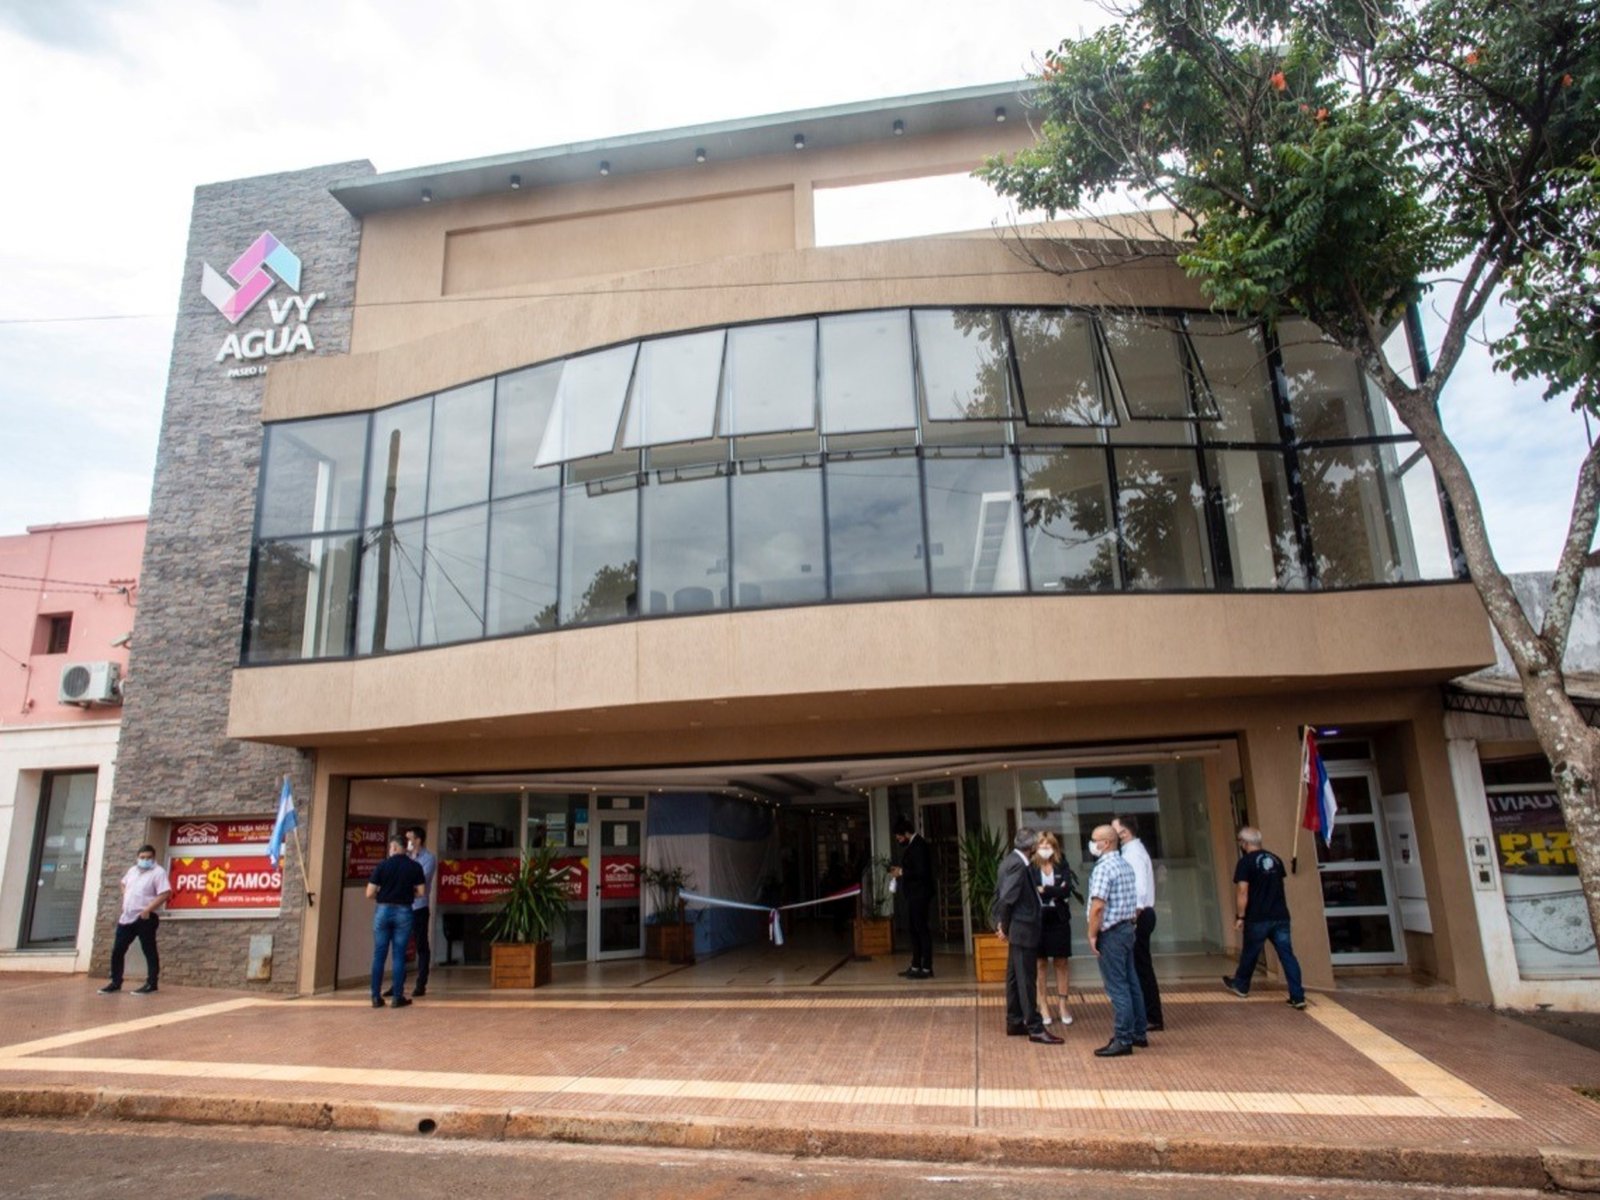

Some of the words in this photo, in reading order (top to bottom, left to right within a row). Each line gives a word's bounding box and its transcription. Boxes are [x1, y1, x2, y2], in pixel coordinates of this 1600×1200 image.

[215, 325, 315, 362] AGUA
[227, 365, 257, 378] PASEO
[176, 836, 219, 845] MICROFIN
[1499, 832, 1572, 850] PIZ
[1502, 850, 1528, 866] X
